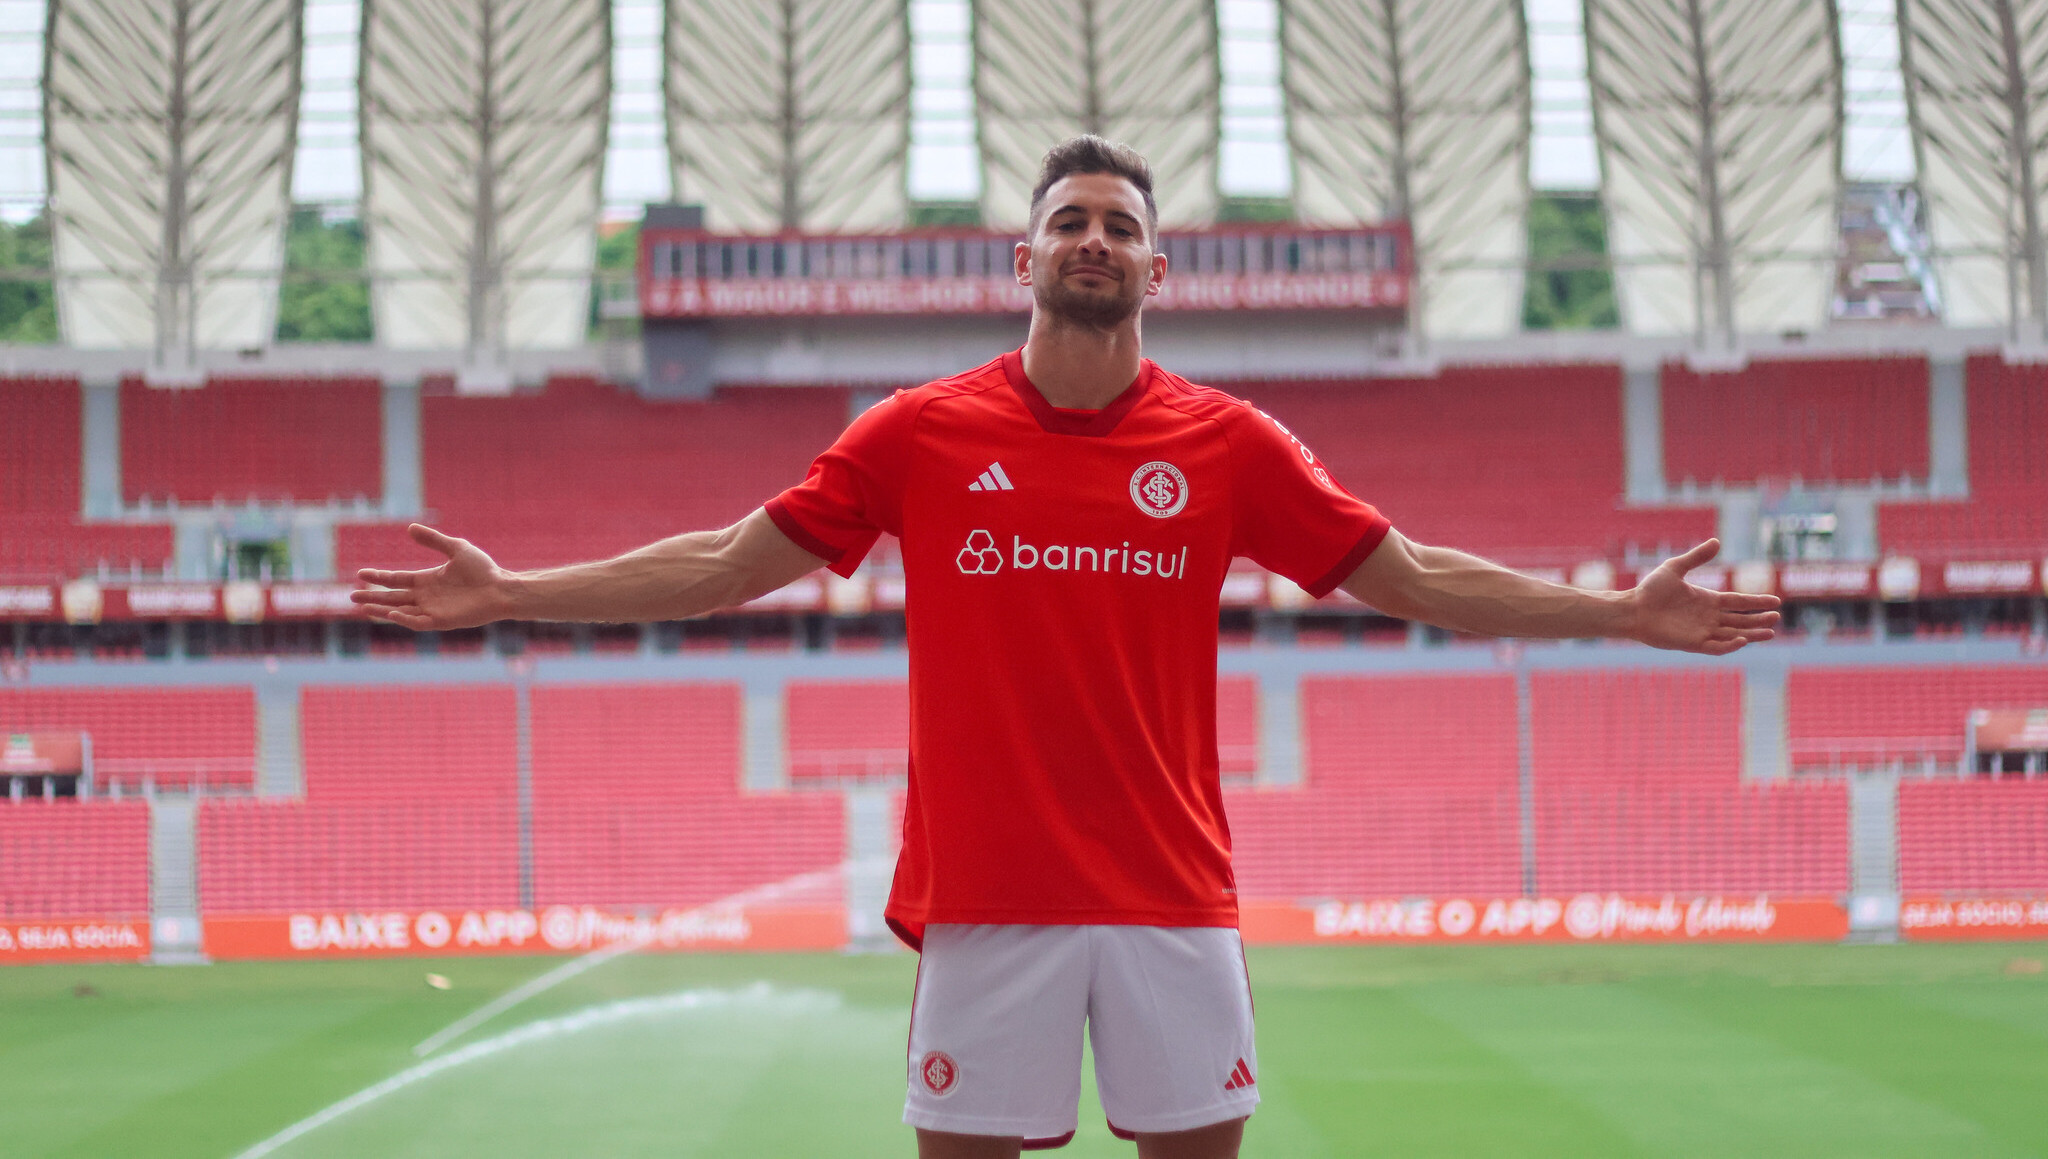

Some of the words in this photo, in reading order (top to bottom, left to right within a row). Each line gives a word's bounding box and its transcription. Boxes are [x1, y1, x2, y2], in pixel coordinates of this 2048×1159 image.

[1013, 535, 1187, 579] banrisul
[289, 913, 411, 950] BAIXE
[415, 911, 451, 948] O
[456, 909, 538, 946] APP
[1314, 899, 1436, 937] BAIXE
[1438, 899, 1476, 936] O
[1479, 897, 1563, 936] APP
